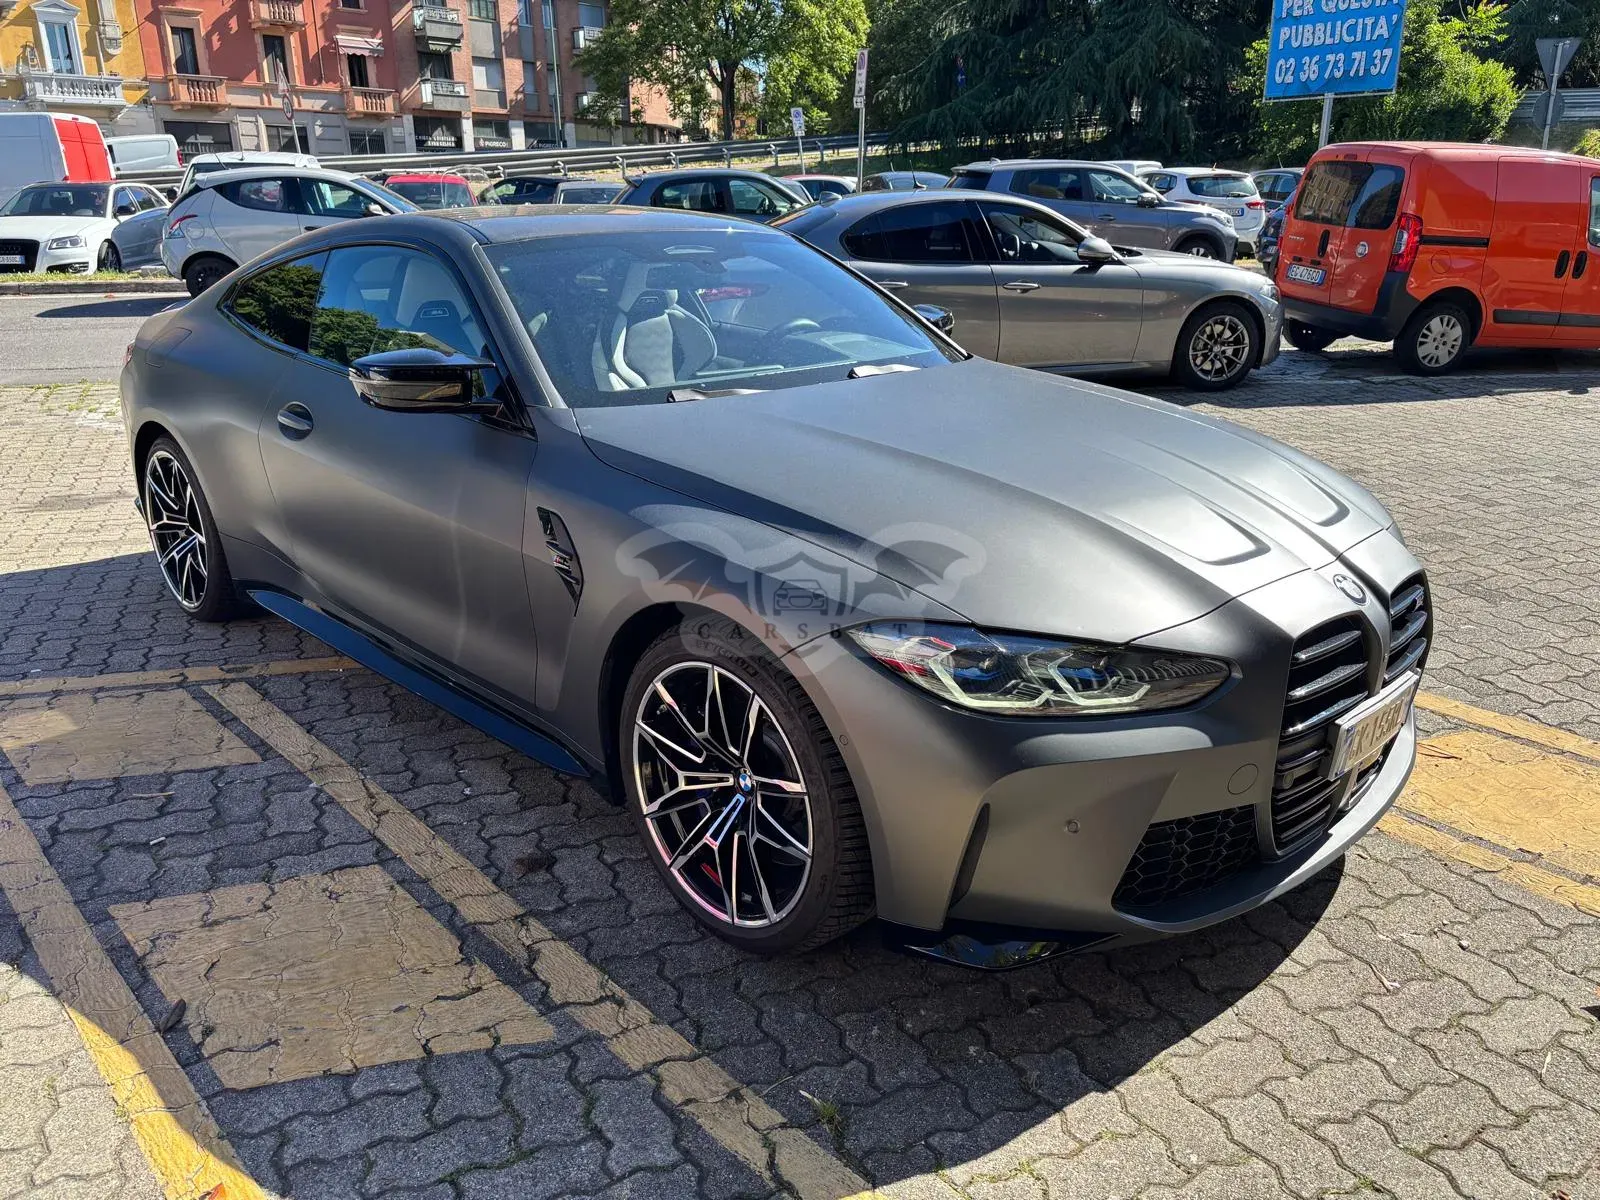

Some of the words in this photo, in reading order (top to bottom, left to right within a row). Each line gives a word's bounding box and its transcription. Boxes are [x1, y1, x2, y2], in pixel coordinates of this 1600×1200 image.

[1281, 0, 1314, 18] PER
[1321, 0, 1398, 13] QUE
[1274, 57, 1296, 84] 02
[1299, 55, 1320, 82] 36
[1324, 52, 1345, 80] 73
[1349, 50, 1367, 78] 71
[1370, 47, 1393, 76] 37
